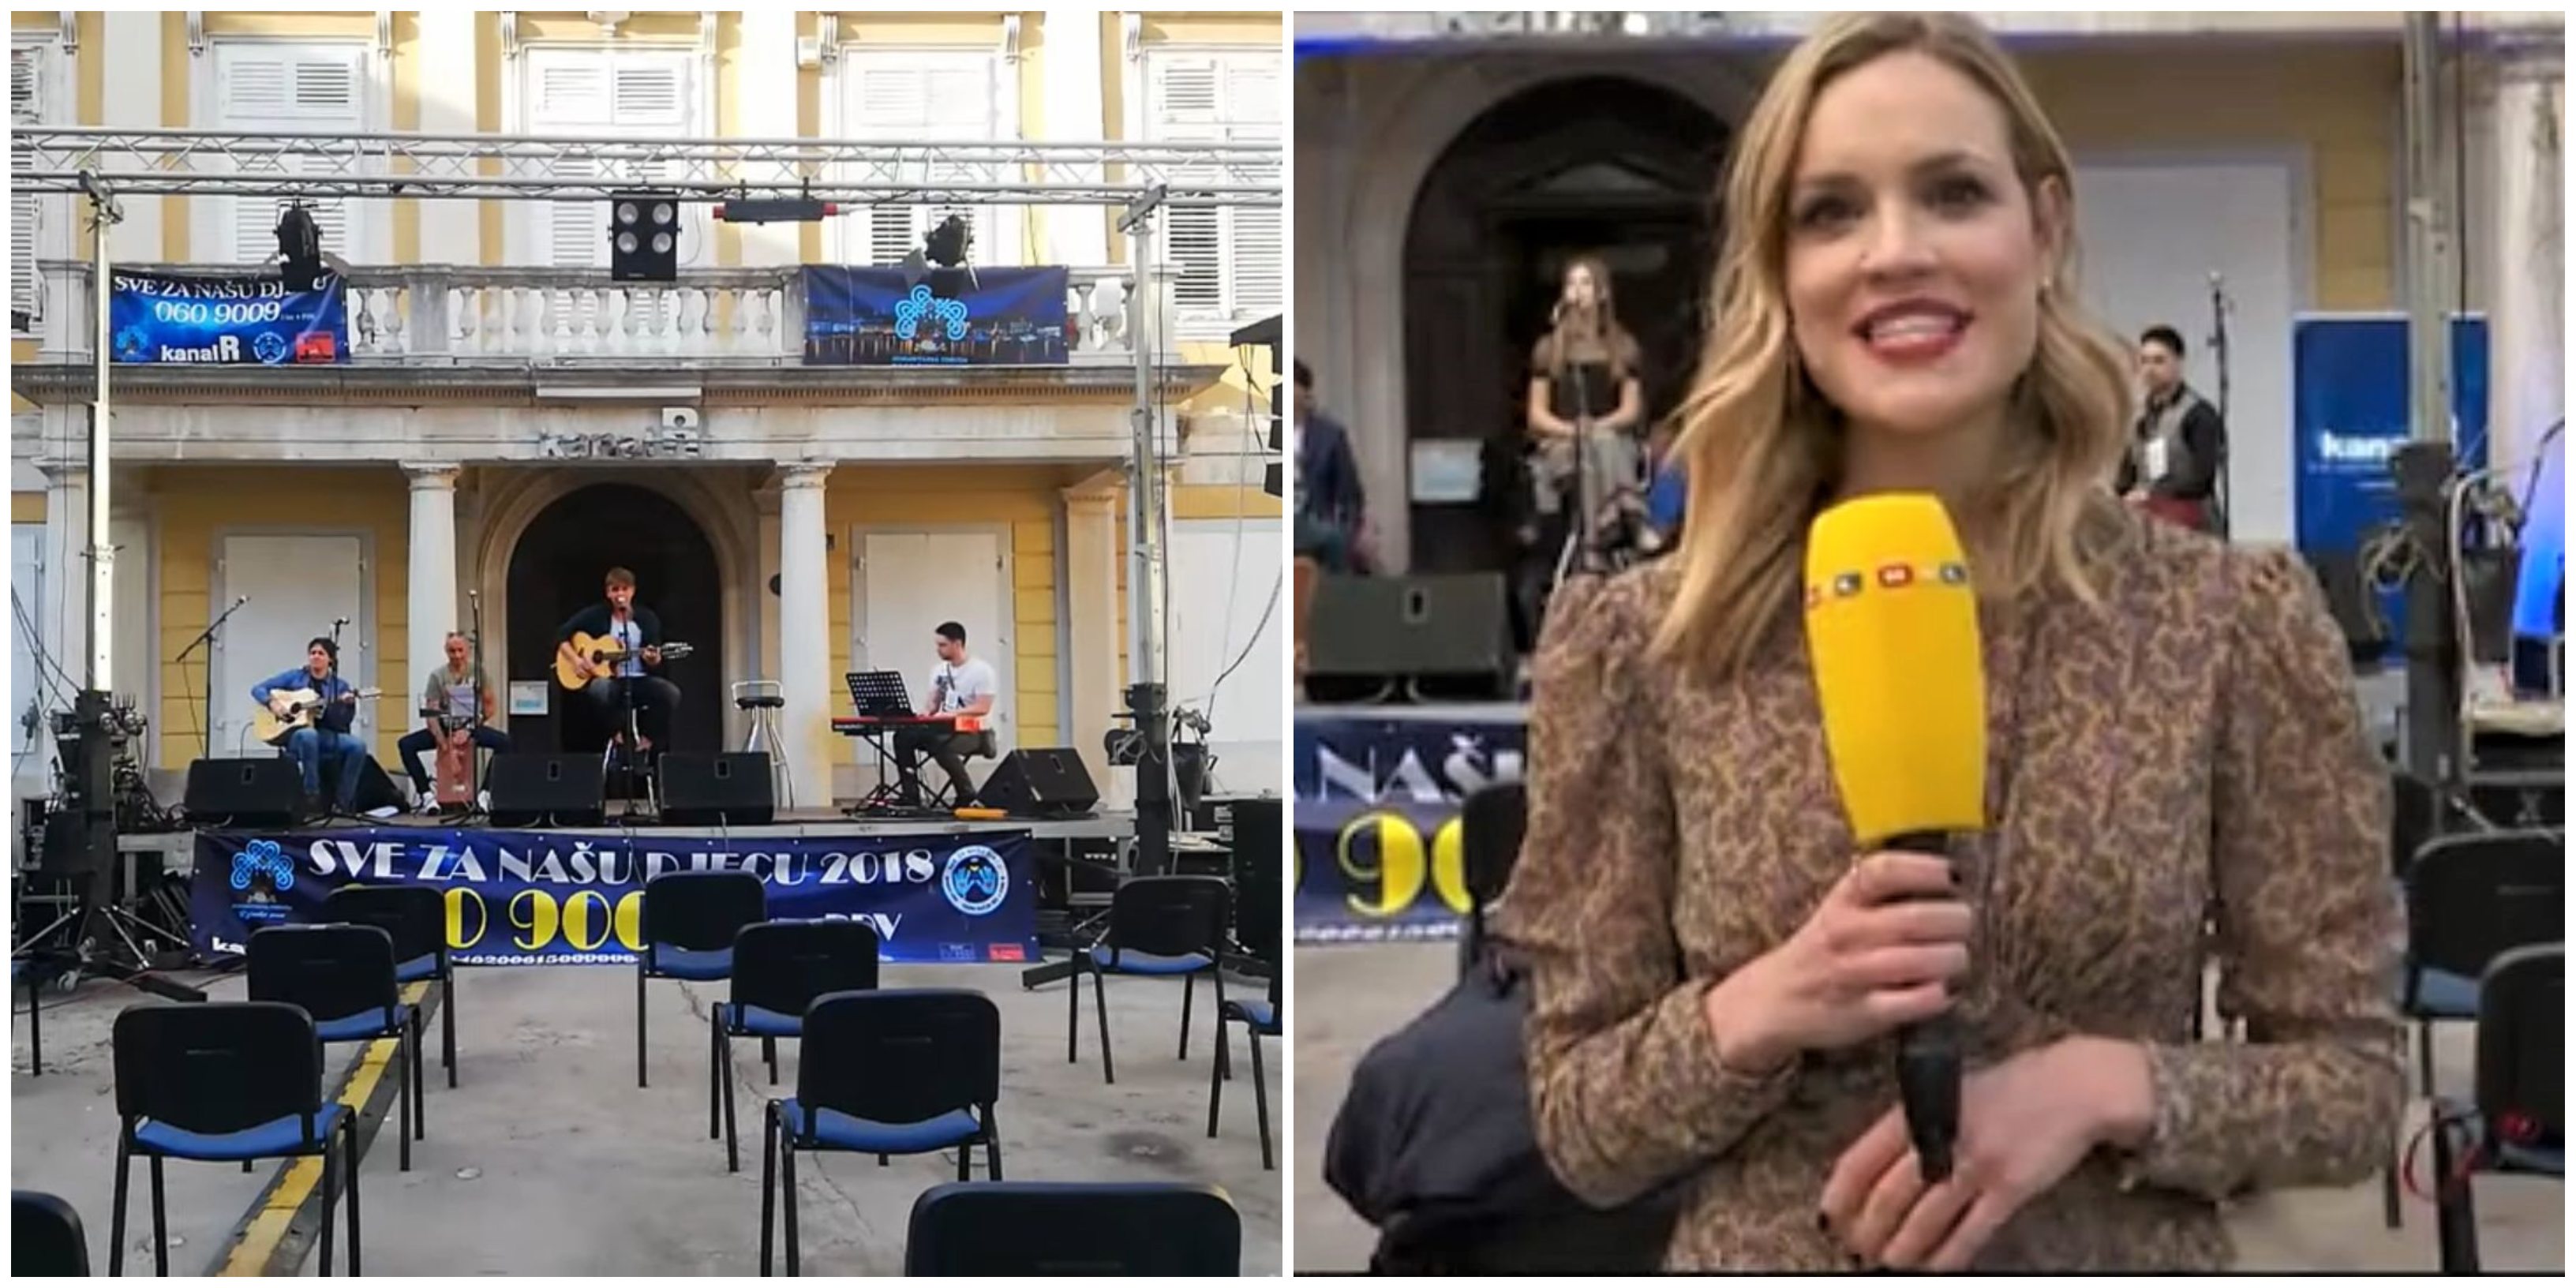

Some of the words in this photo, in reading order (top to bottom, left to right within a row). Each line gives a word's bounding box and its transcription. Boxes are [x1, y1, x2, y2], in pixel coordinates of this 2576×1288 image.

[114, 276, 158, 295] SVE
[161, 280, 191, 298] ZA
[193, 279, 254, 299] NAŠU
[155, 301, 208, 324] 060
[213, 301, 281, 324] 9009
[309, 839, 405, 878] SVE
[417, 844, 487, 882] ZA
[498, 841, 633, 885] NAŠU
[818, 848, 935, 884] 2018
